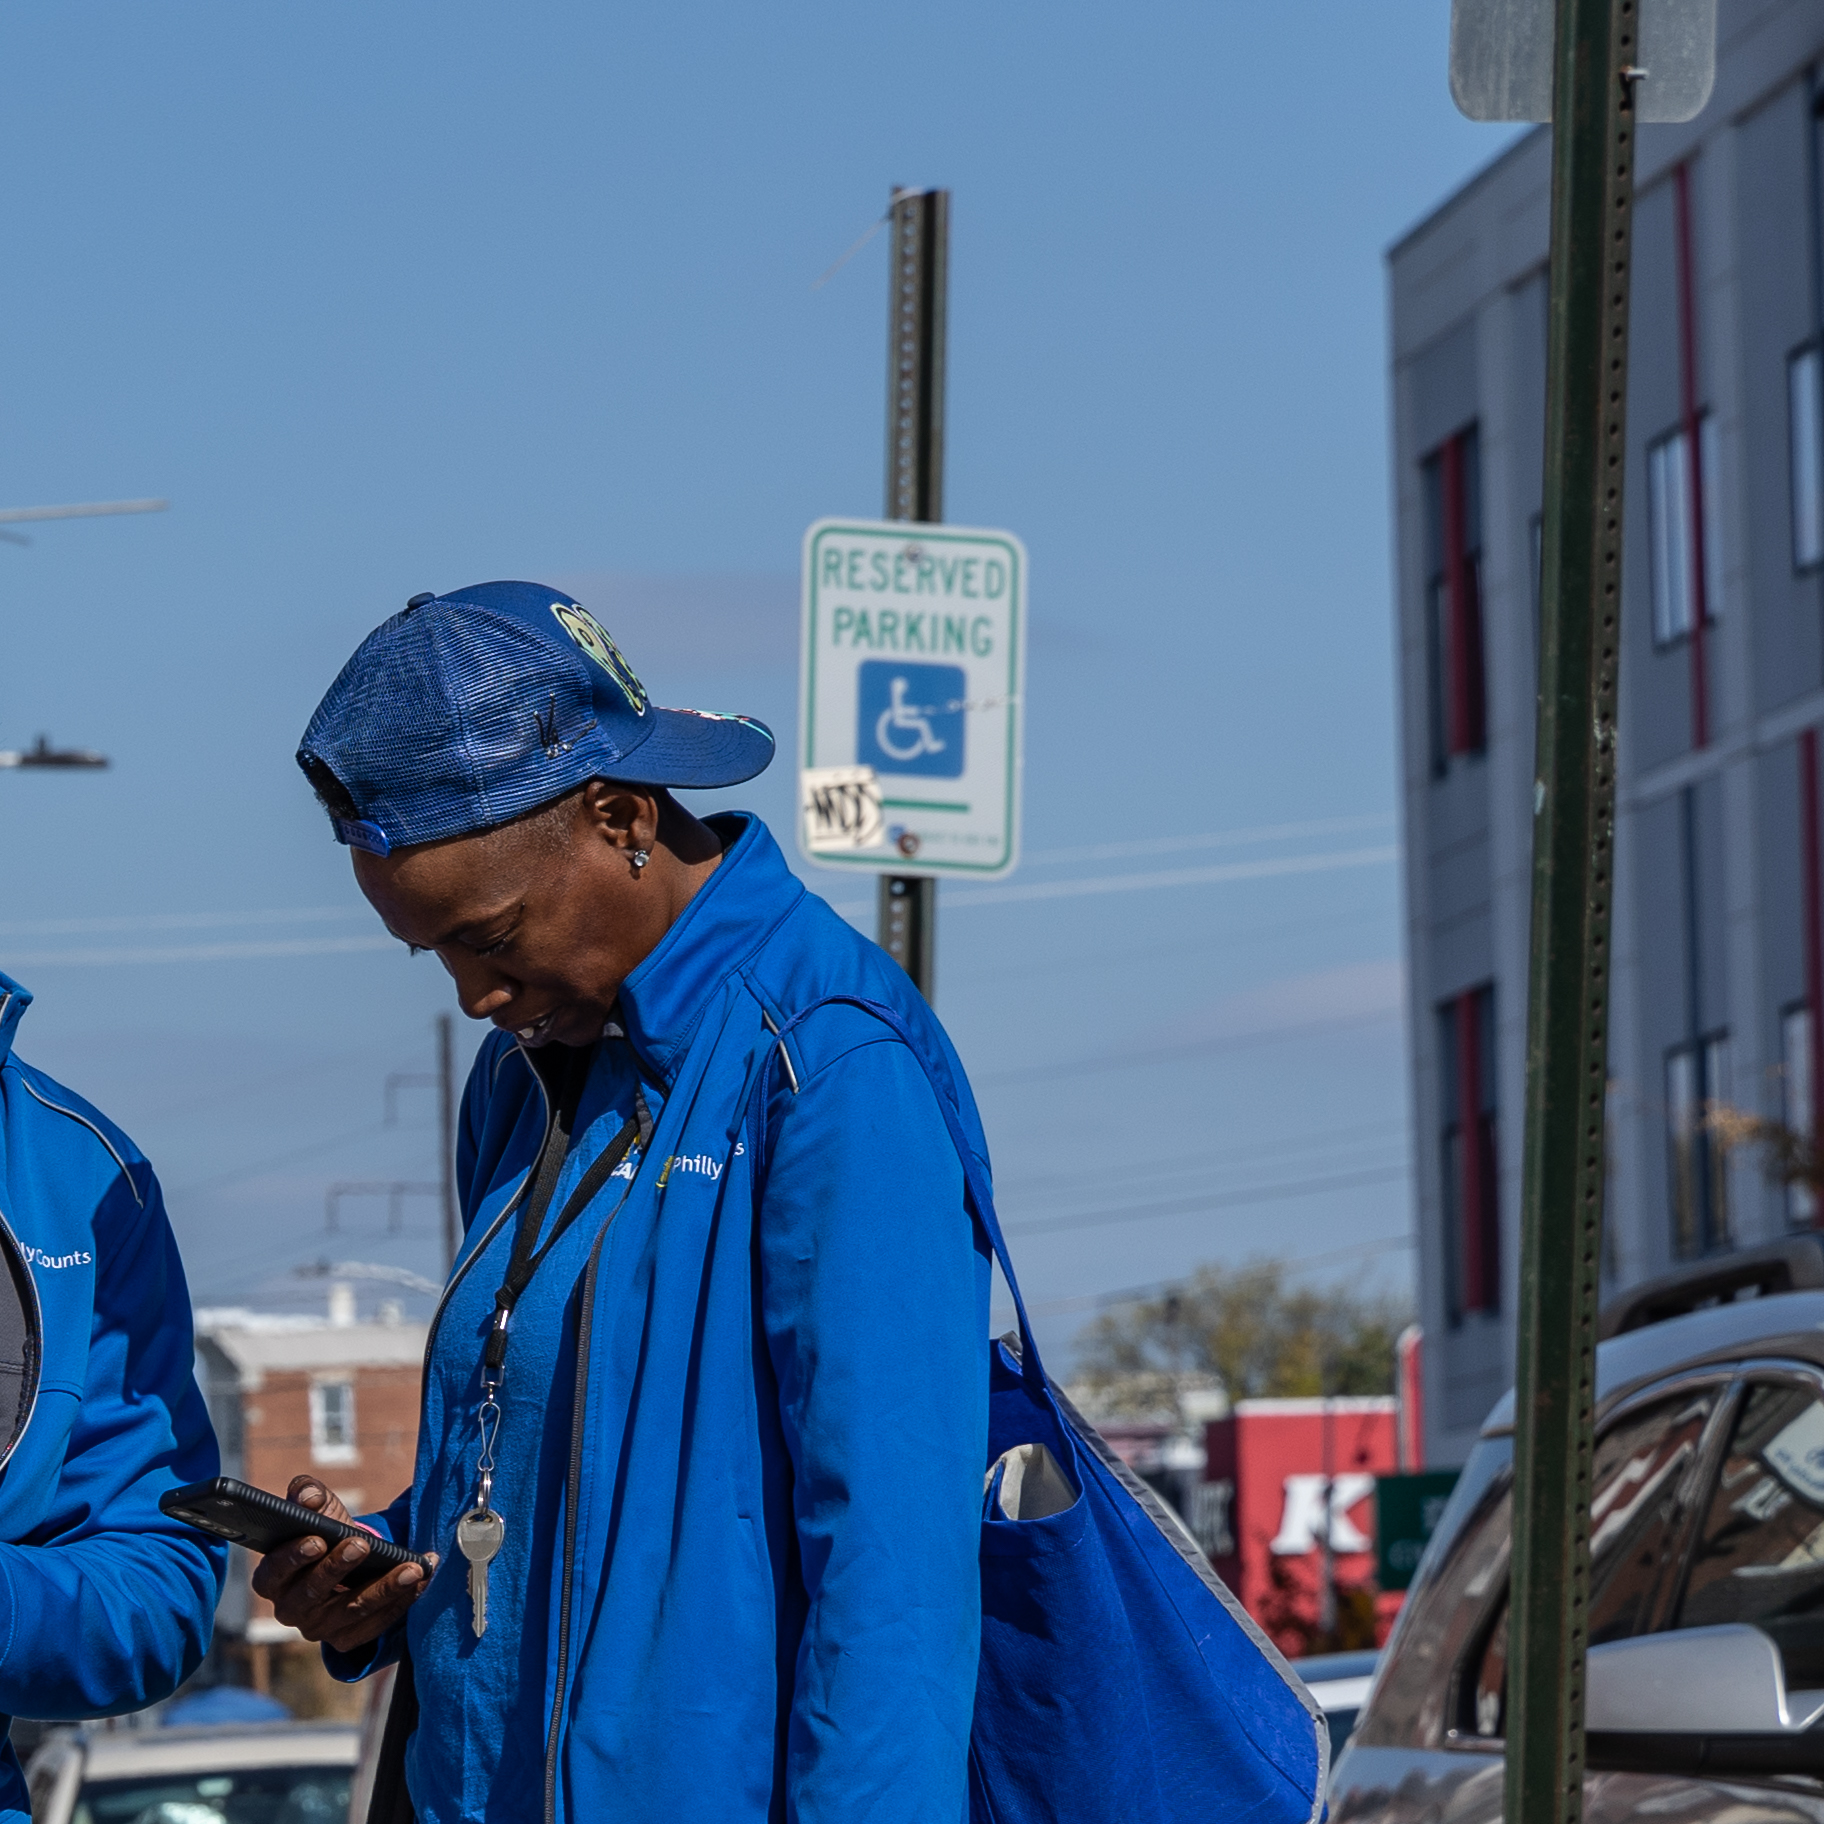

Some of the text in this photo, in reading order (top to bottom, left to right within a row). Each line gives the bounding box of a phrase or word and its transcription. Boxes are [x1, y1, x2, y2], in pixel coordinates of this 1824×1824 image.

[821, 547, 1007, 600] RESERVED
[832, 606, 995, 658] PARKING
[1270, 1473, 1376, 1555] K
